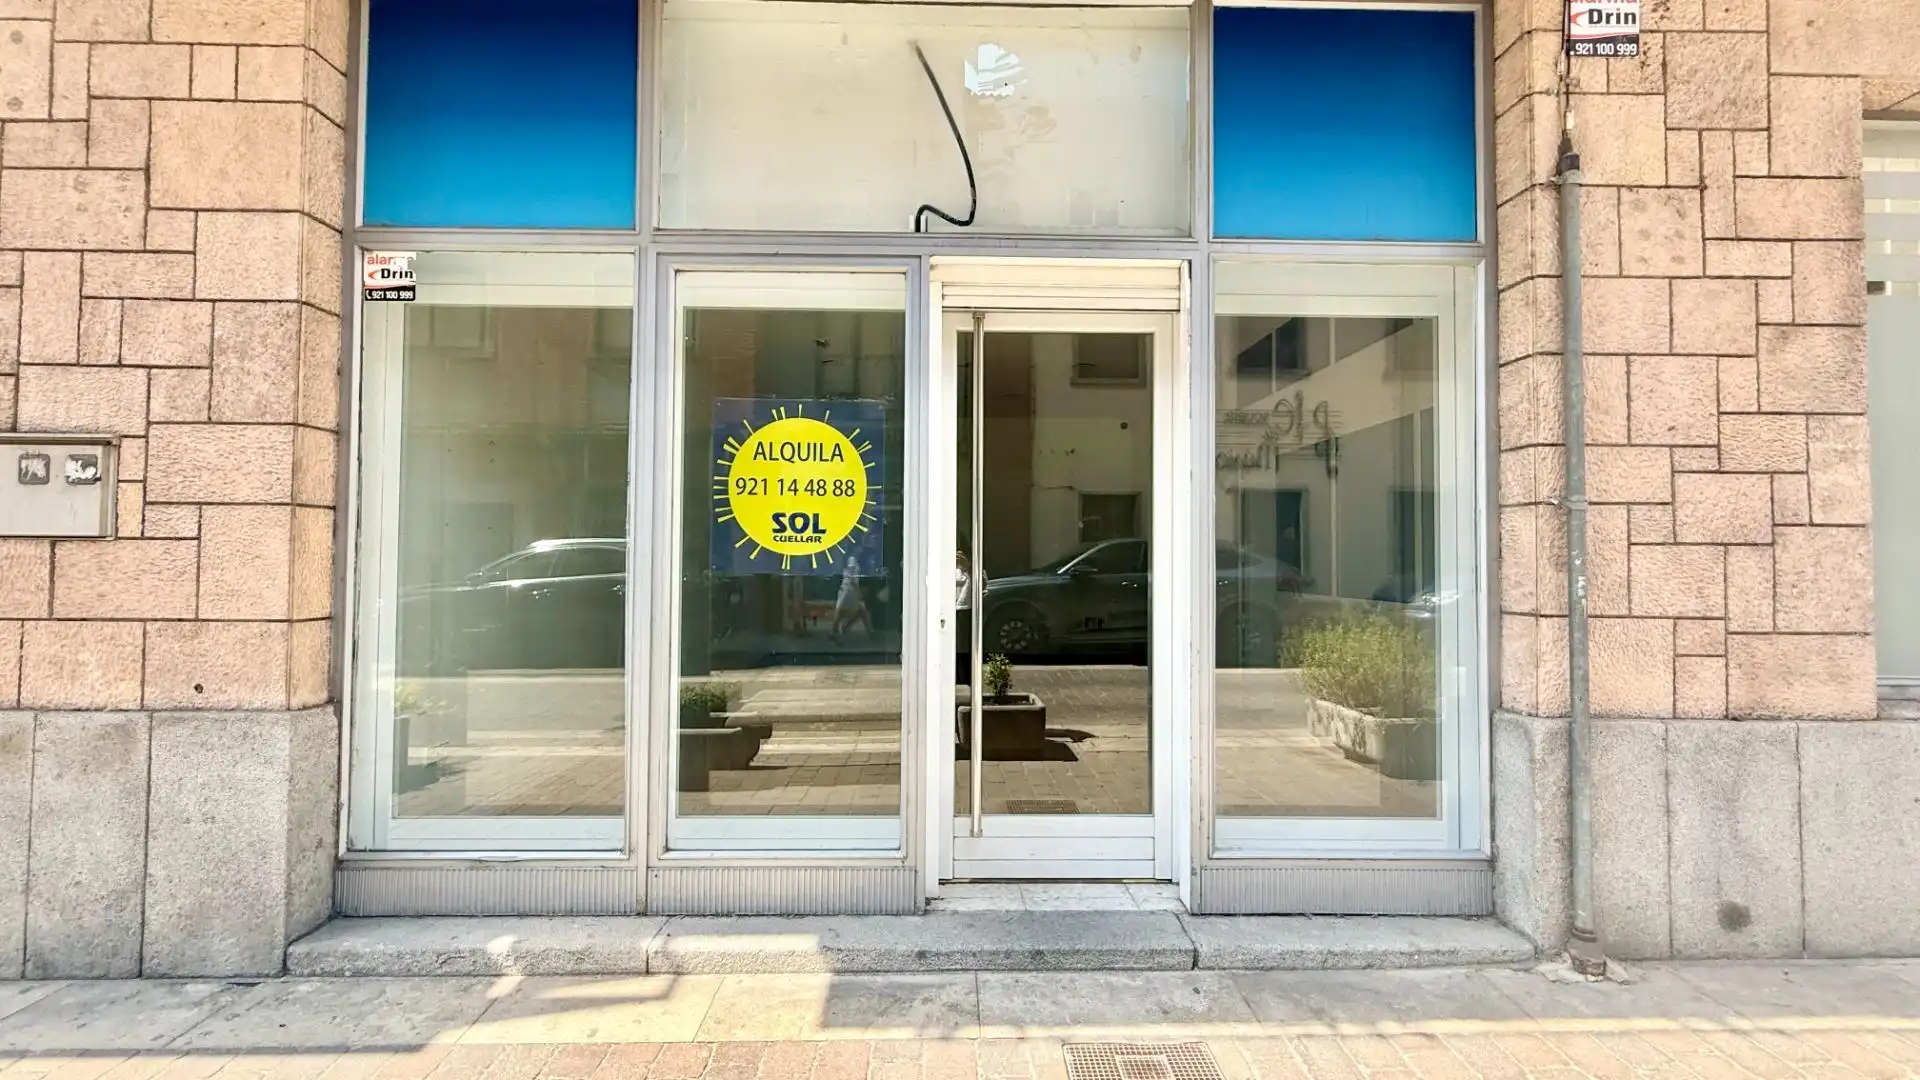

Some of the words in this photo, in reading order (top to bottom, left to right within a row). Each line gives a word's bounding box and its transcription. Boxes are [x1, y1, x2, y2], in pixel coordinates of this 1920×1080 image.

[1588, 8, 1637, 25] Drin
[1575, 43, 1593, 55] 921
[1595, 43, 1614, 55] 100
[1616, 43, 1637, 55] 999
[367, 253, 414, 265] alar
[380, 268, 413, 279] Drin
[371, 290, 384, 299] 921
[399, 290, 413, 299] 999
[753, 441, 844, 464] ALQUILA
[735, 477, 768, 496] 921
[777, 478, 799, 496] 14
[804, 479, 827, 497] 48
[832, 479, 855, 497] 88
[771, 512, 827, 534] SOL
[773, 535, 822, 544] CUELLAR
